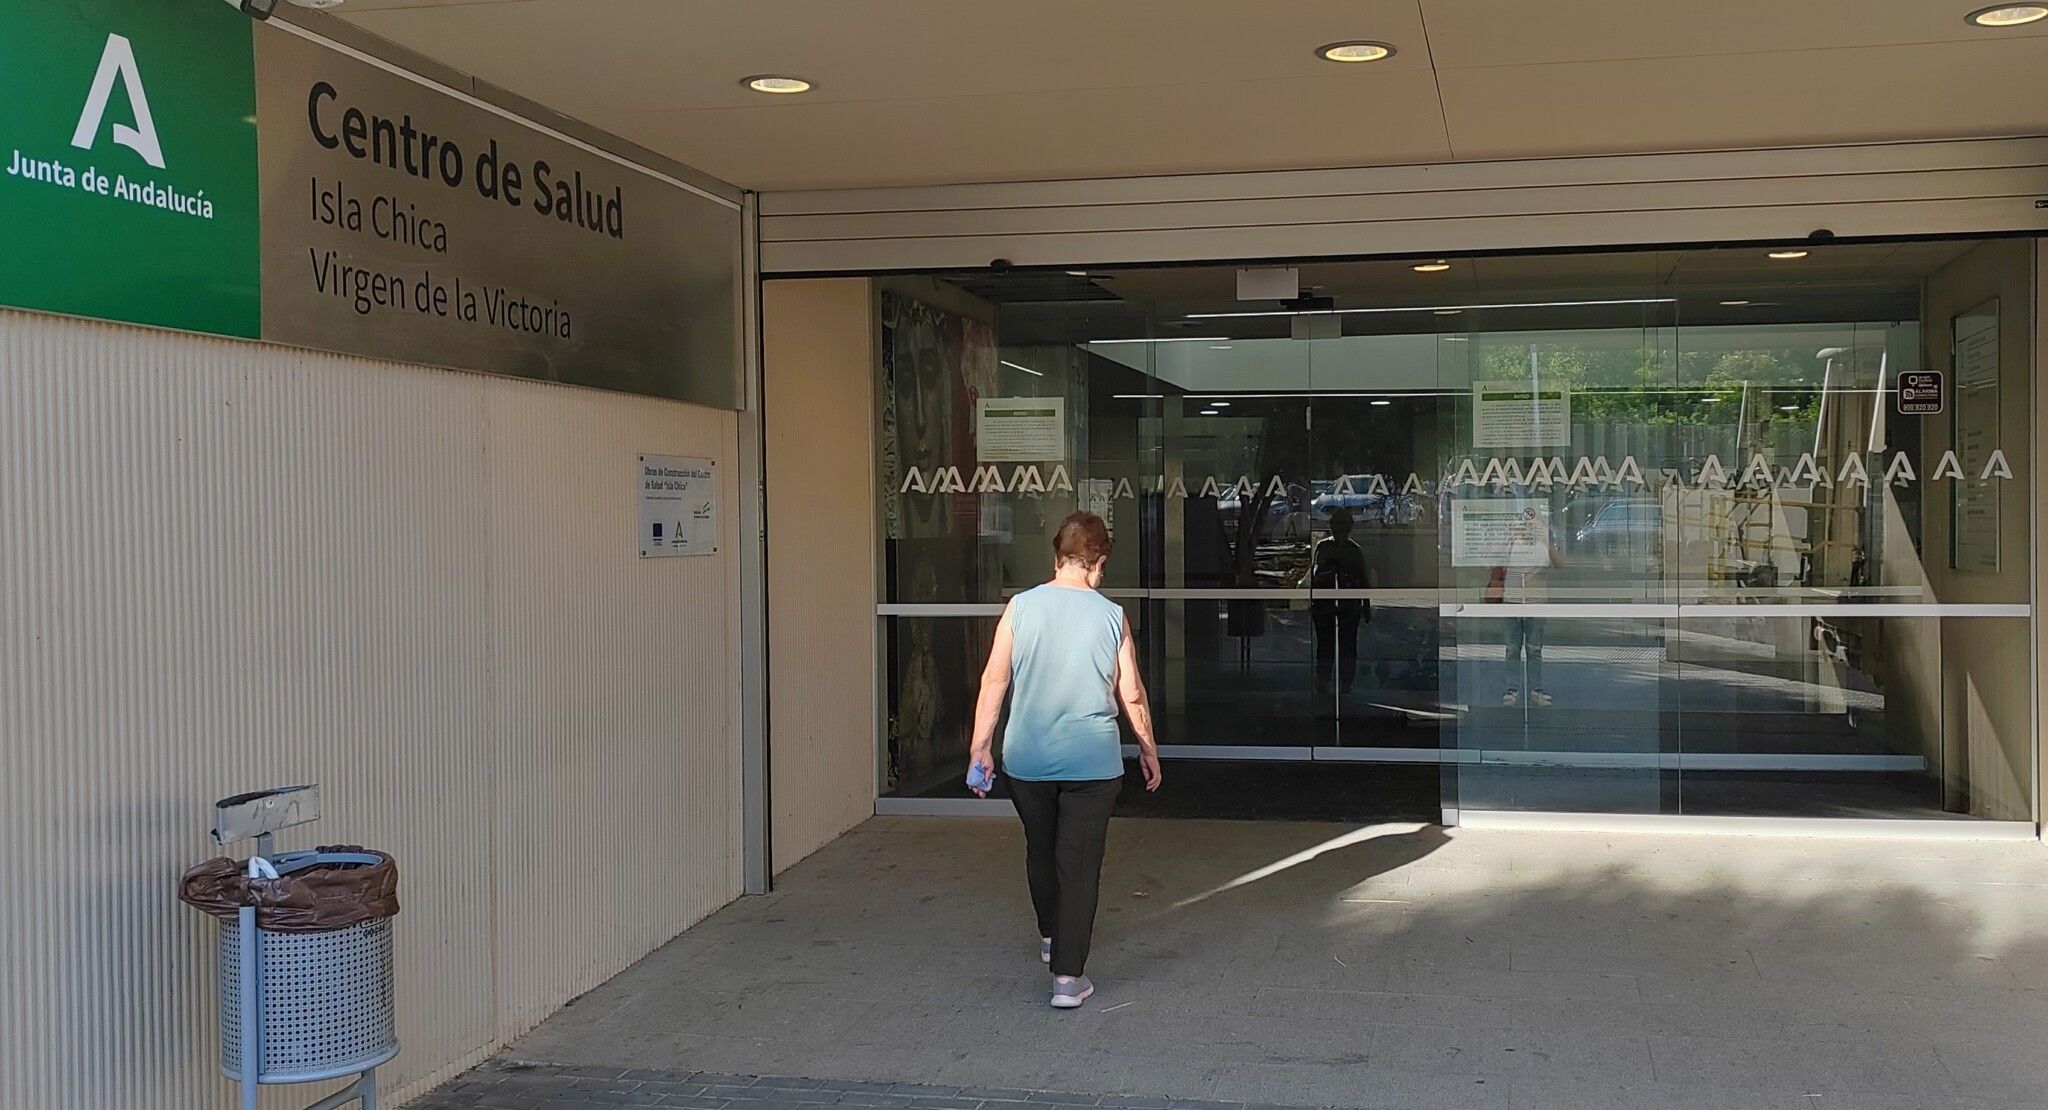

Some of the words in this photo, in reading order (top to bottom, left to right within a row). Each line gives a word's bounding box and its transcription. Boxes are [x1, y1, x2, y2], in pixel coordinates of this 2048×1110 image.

[7, 150, 75, 187] Junta
[82, 166, 109, 195] de
[114, 174, 213, 218] Andalucía
[308, 81, 463, 188] Centro
[476, 138, 522, 207] de
[533, 160, 623, 239] Salud
[311, 177, 361, 232] Isla
[372, 196, 447, 253] Chica
[310, 248, 405, 314] Virgen
[415, 271, 447, 316] de
[456, 277, 477, 322] la
[483, 286, 571, 339] Victoria
[645, 466, 658, 476] Obras
[658, 467, 664, 477] de
[645, 480, 650, 489] de
[651, 480, 663, 489] Salud
